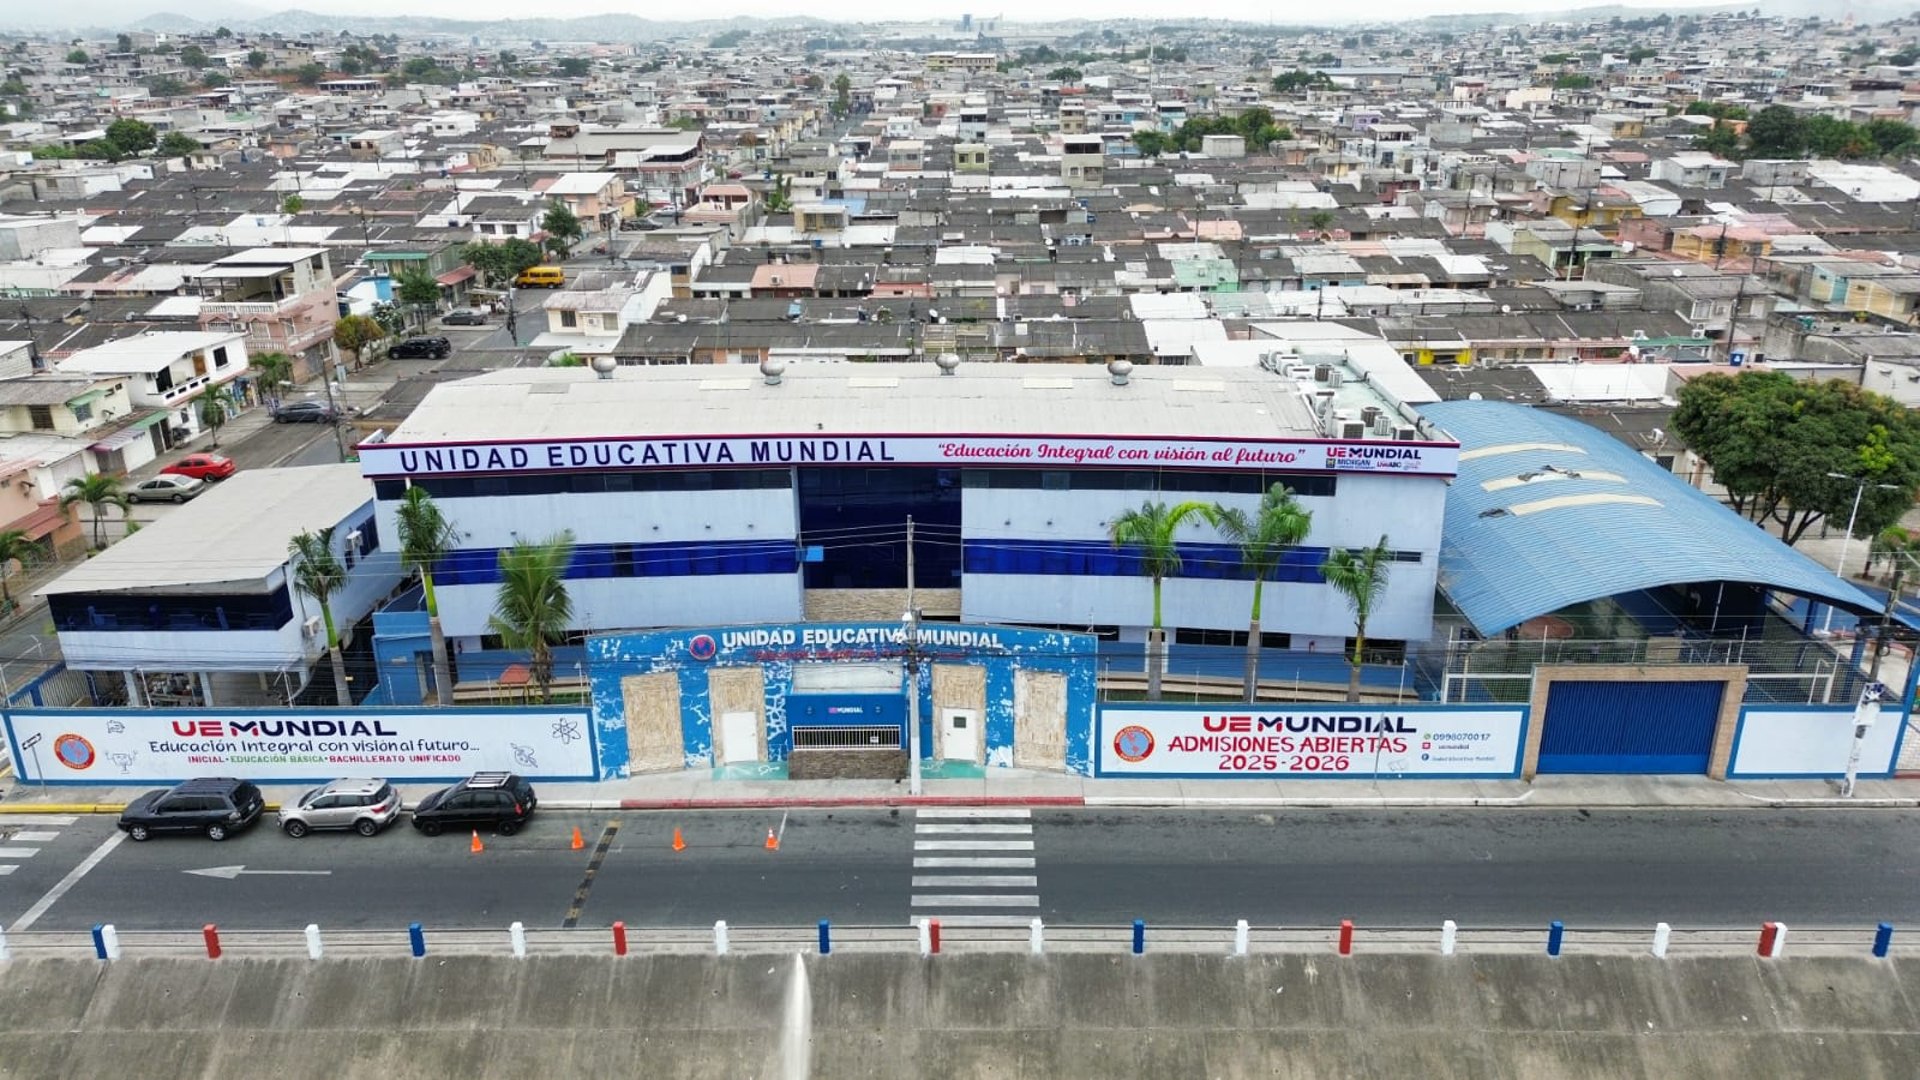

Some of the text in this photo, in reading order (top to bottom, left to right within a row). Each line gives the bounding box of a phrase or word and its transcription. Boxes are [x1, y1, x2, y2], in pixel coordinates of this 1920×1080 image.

[400, 441, 894, 472] UNIDAD EDUCATIVA MUNDIAL
[1037, 444, 1114, 463] Integral
[1118, 448, 1149, 460] con
[1154, 446, 1206, 461] visión
[1212, 447, 1233, 462] al
[1326, 447, 1421, 460] UE MUNDIAL
[722, 629, 795, 647] UNIDAD
[802, 628, 911, 644] EDUCATIVA
[917, 629, 1003, 649] MUNDIAL
[172, 720, 397, 737] UE MUNDIAL
[1203, 716, 1417, 733] UE MUNDIAL
[150, 740, 237, 753] Educación
[242, 740, 313, 755] Integral
[318, 741, 349, 752] con
[400, 740, 414, 752] al
[1168, 736, 1294, 753] ADMISIONES
[1299, 736, 1408, 753] ABIERTAS
[188, 755, 225, 763] INICIAL
[329, 754, 405, 763] BACHILLERATO
[409, 754, 461, 762] UNIFICADO
